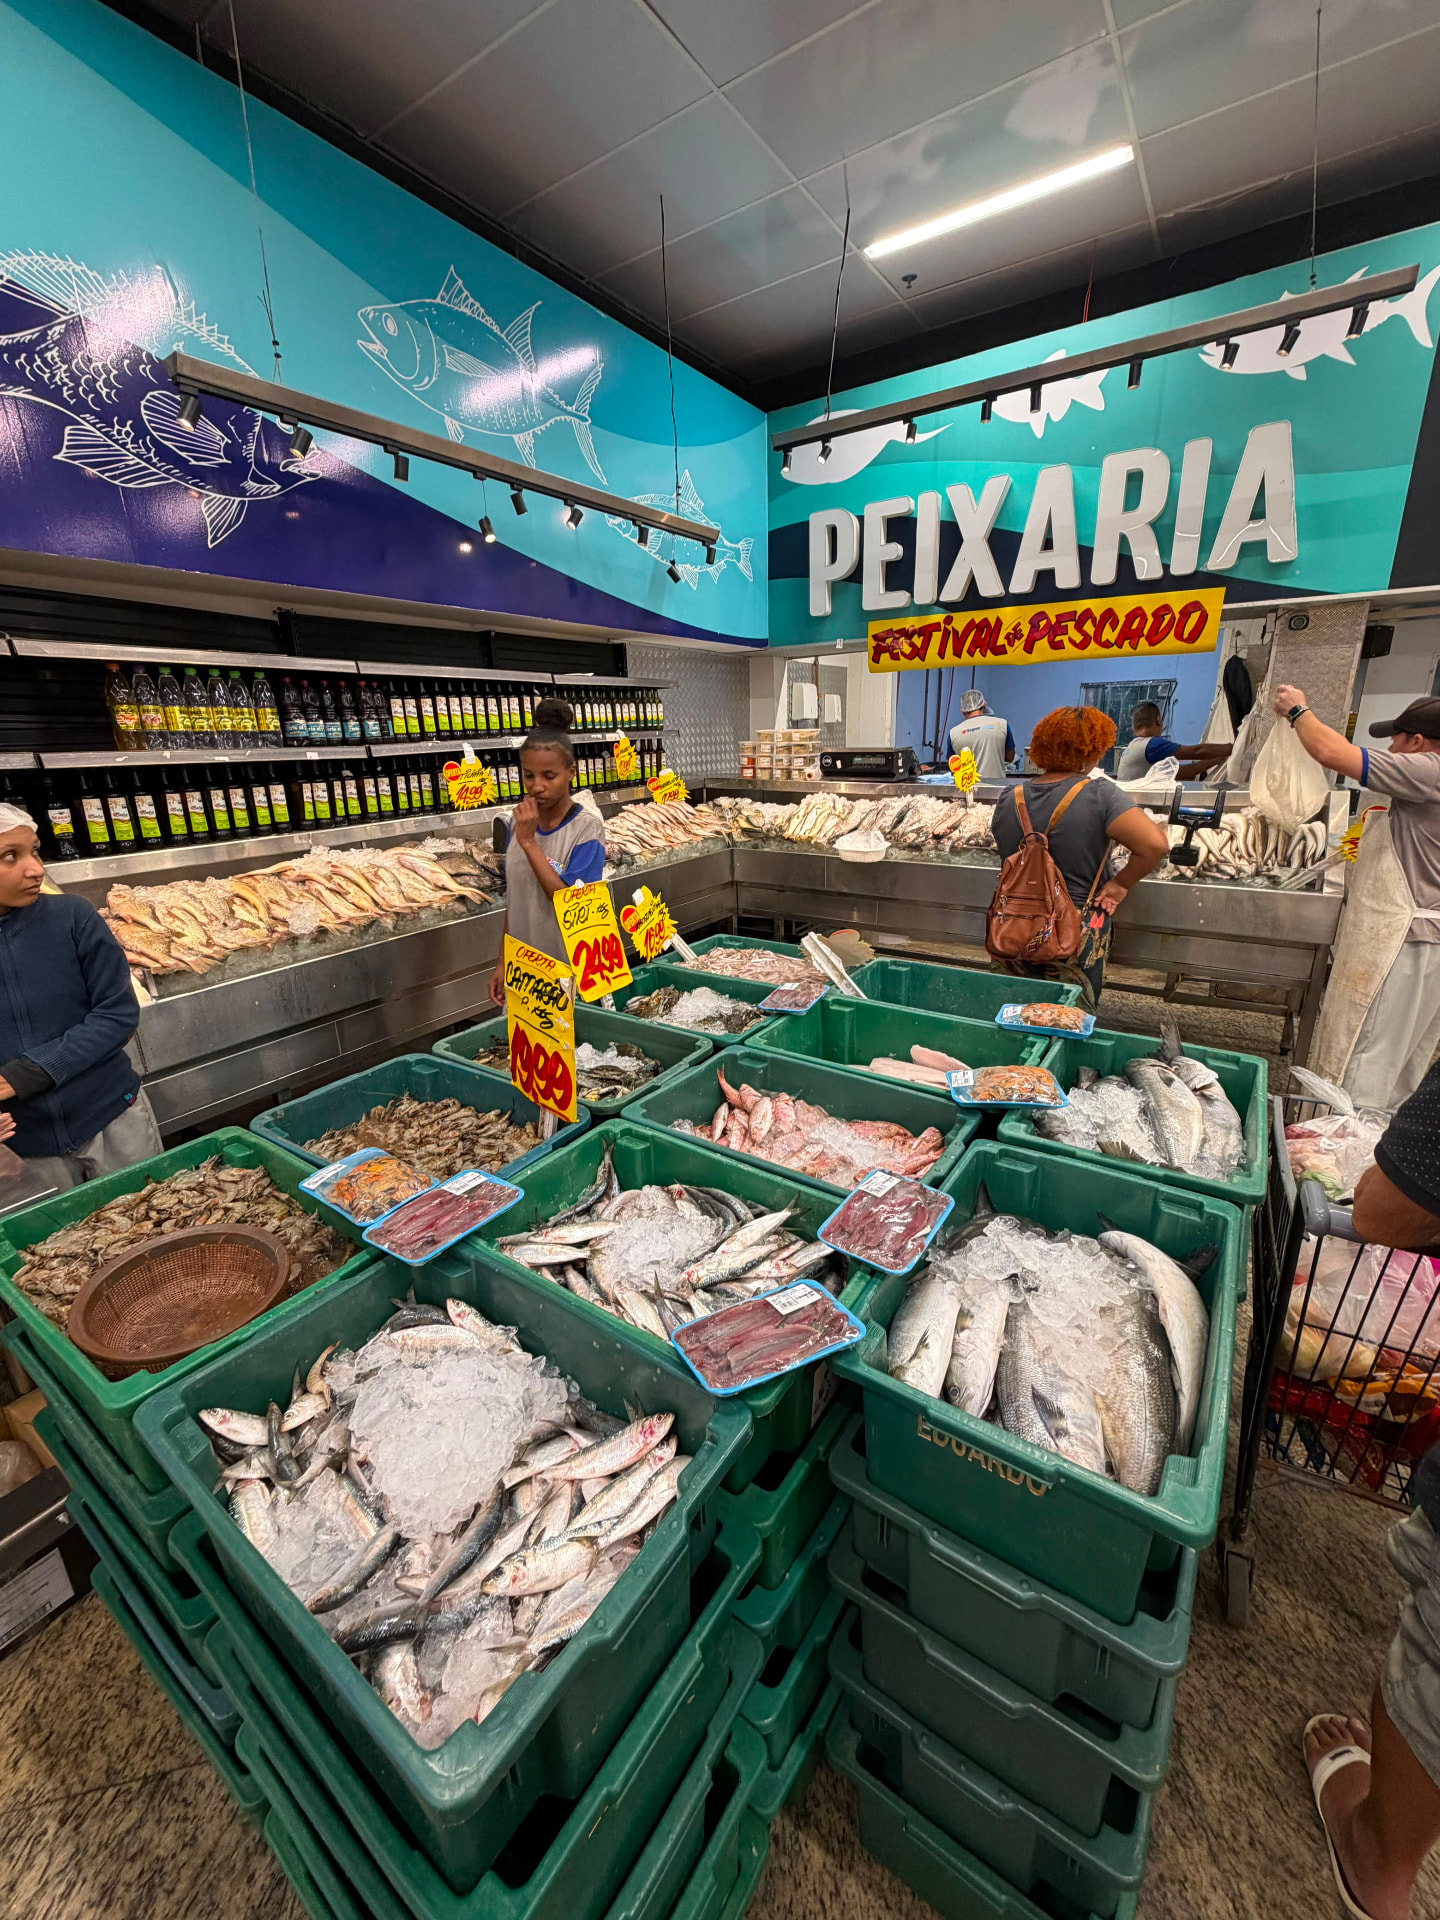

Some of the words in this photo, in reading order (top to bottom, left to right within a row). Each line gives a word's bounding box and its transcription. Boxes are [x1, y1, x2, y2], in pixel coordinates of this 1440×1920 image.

[808, 419, 1298, 617] PEIXARIA
[1022, 600, 1208, 654] PESCADO
[515, 946, 556, 971] OFERTA
